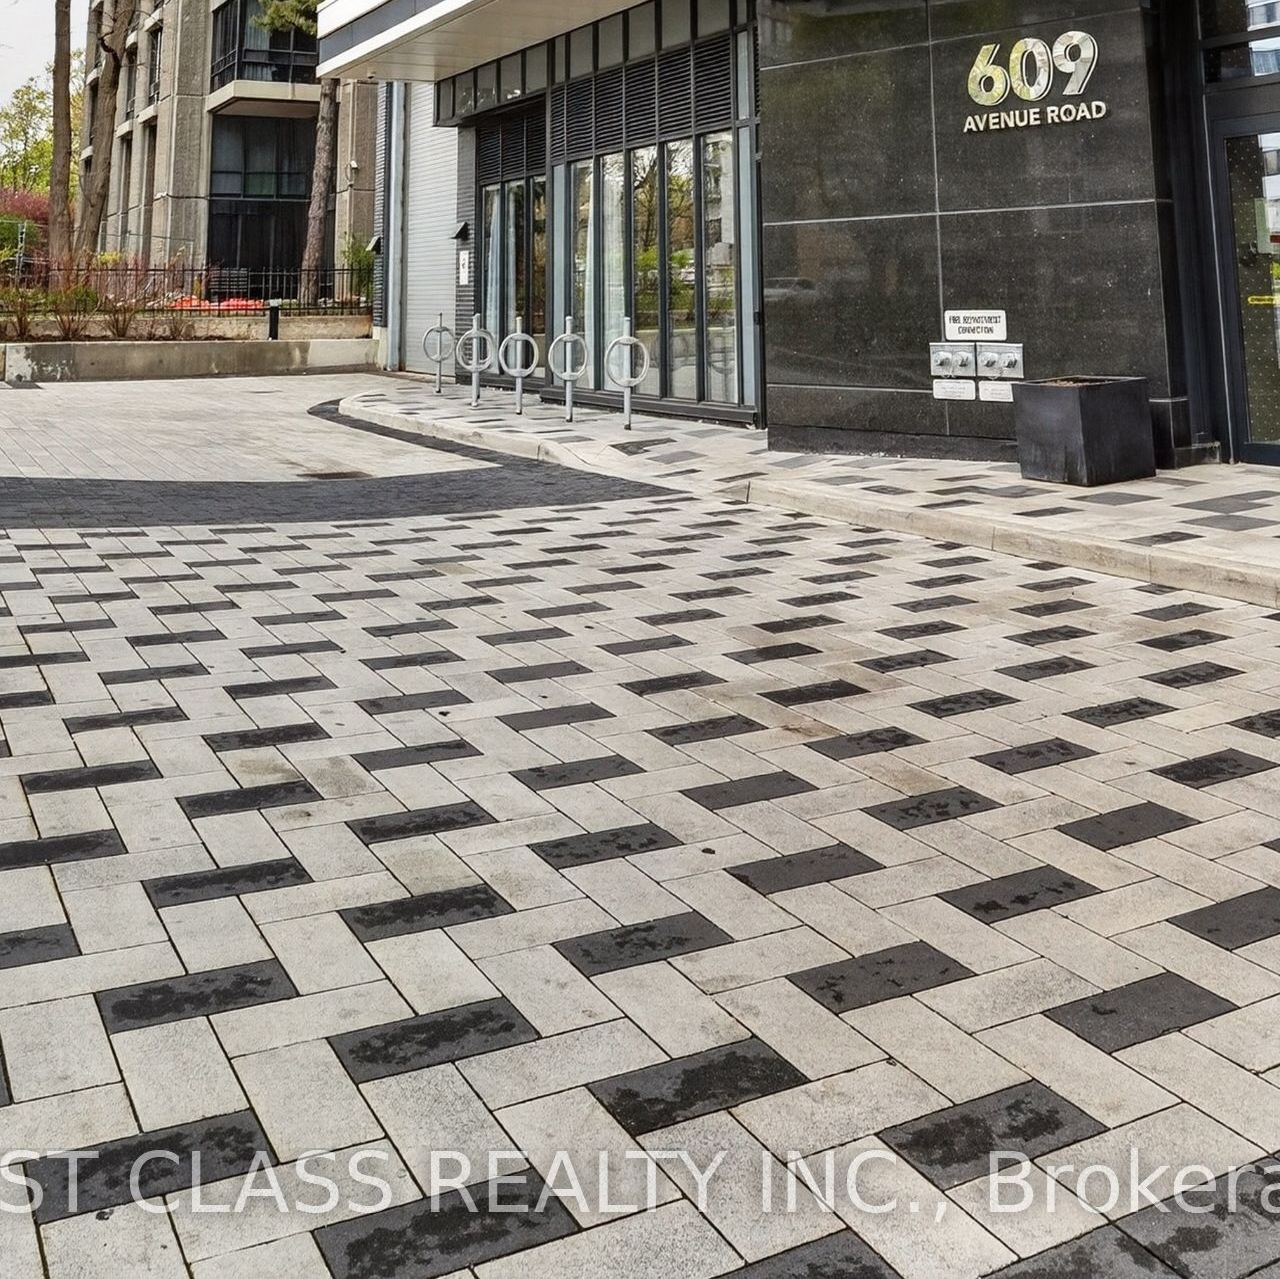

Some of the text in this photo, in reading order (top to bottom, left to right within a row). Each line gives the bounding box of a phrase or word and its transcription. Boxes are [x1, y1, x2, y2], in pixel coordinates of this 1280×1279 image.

[968, 31, 1098, 106] 609
[963, 101, 1107, 133] AVENUE ROAD
